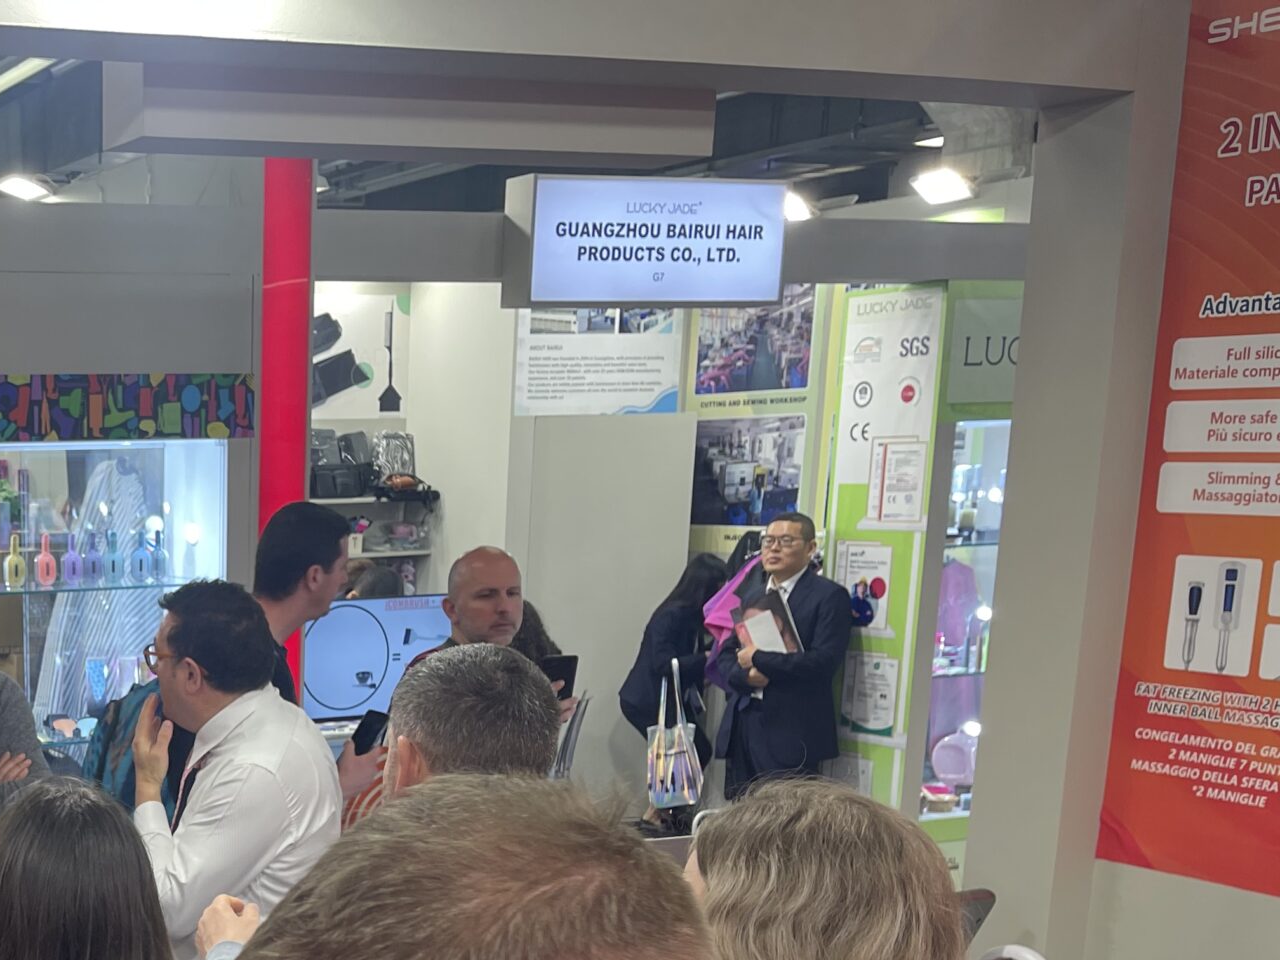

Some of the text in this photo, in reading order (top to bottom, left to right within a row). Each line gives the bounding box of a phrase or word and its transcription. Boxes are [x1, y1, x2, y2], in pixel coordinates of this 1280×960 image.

[1218, 117, 1243, 158] 2
[626, 201, 667, 214] LUCKY
[555, 221, 764, 240] GUANGZHOU BAIRUI HAIR
[577, 245, 740, 266] PRODUCTS CO., LTD.
[652, 272, 665, 282] G7
[857, 300, 898, 315] LUCKY
[899, 335, 931, 358] SGS
[1226, 346, 1251, 361] Full
[1174, 365, 1238, 380] Materiale
[700, 400, 727, 408] CUTTING
[728, 399, 741, 407] AND
[769, 395, 807, 405] WORKSHOP
[1210, 409, 1278, 425] More safe
[1206, 428, 1227, 442] Più
[1231, 428, 1273, 442] sicuro
[1207, 471, 1271, 489] Slimming
[1135, 681, 1161, 697] FAT
[1160, 685, 1221, 704] FREEZING
[1223, 691, 1260, 708] WITH
[1261, 697, 1271, 711] 2
[1147, 700, 1188, 717] INNER
[1190, 705, 1221, 721] BALL
[1135, 727, 1233, 751] CONGELAMENTO
[1235, 742, 1257, 756] DEL
[1168, 748, 1177, 760] 2
[1178, 749, 1238, 770] MANIGLIE
[1239, 760, 1248, 770] 7
[1130, 759, 1279, 793] MASSAGGIO DELLA SFERA
[1206, 787, 1268, 808] MANIGLIE
